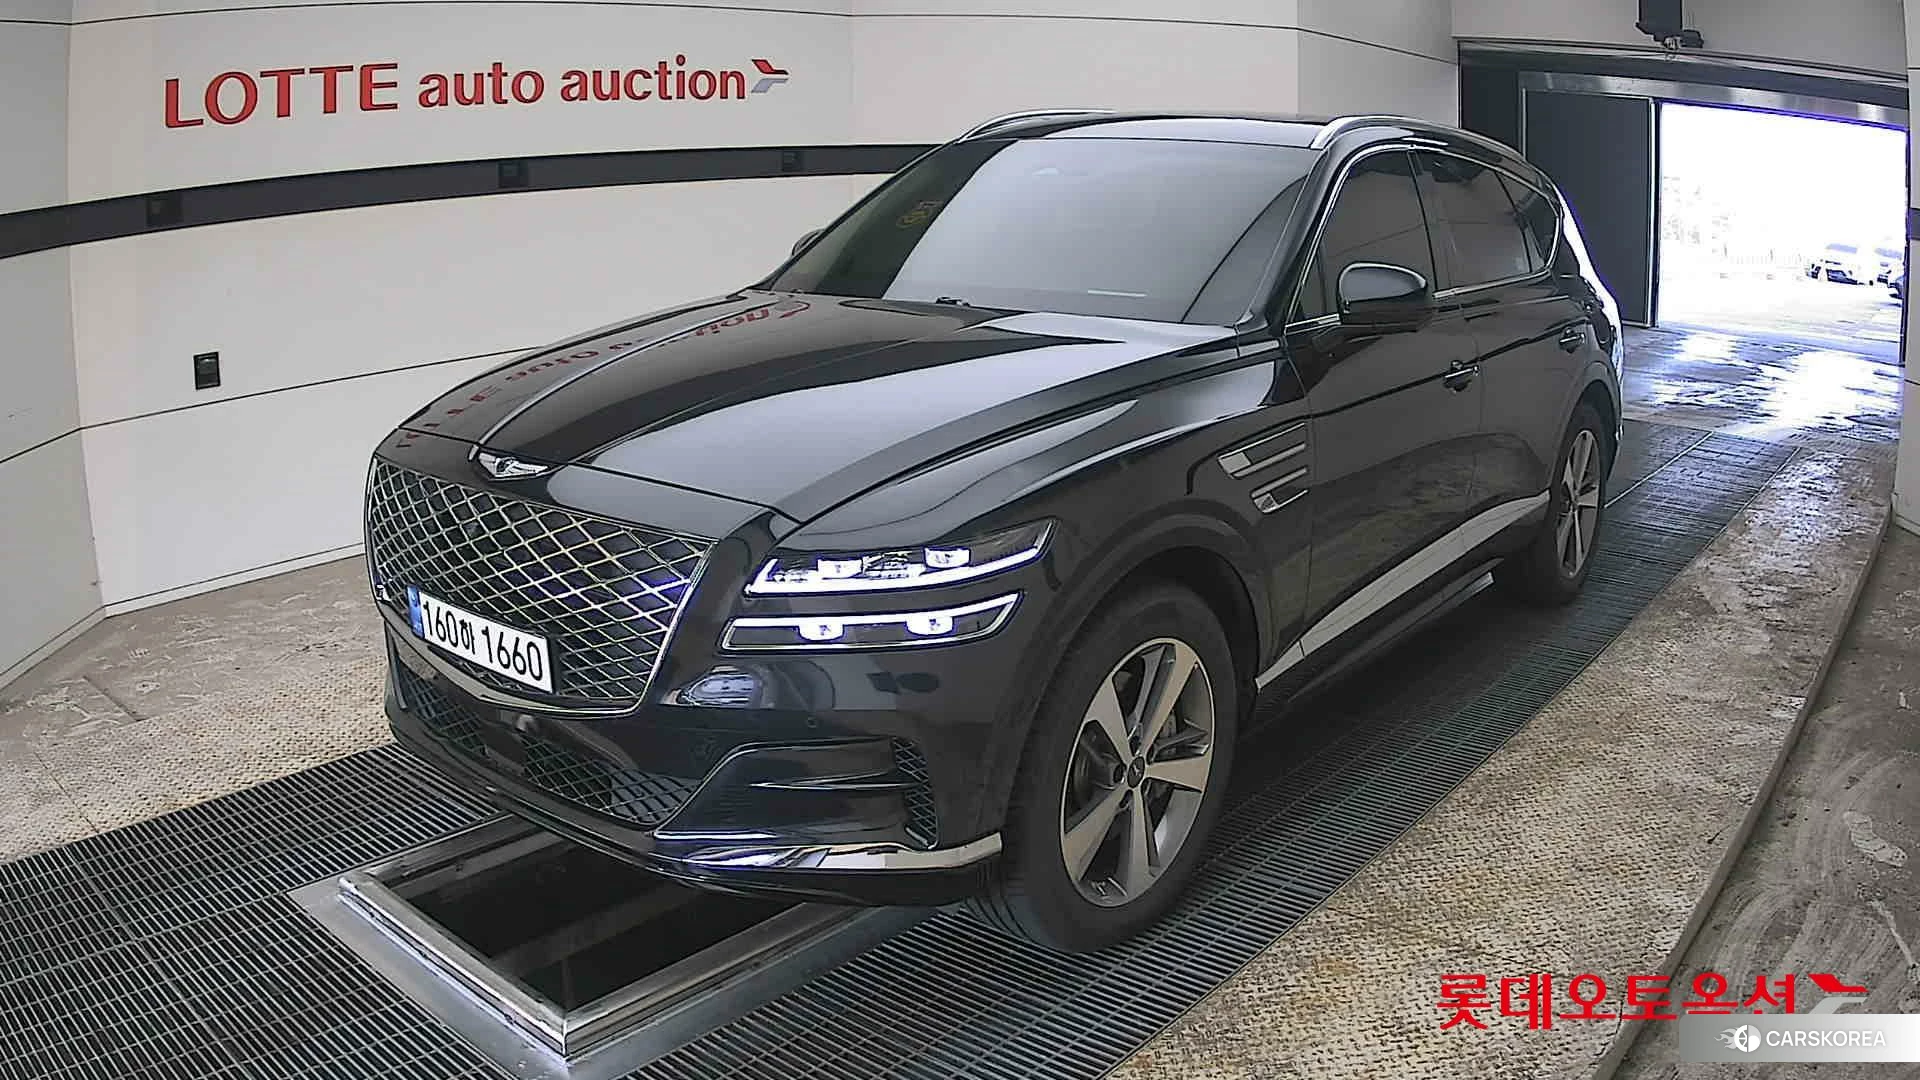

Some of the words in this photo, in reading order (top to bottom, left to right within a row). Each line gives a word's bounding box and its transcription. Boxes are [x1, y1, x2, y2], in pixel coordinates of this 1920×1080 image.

[164, 62, 399, 129] LOTTE
[417, 61, 545, 109] auto
[559, 54, 747, 102] auction
[481, 626, 544, 682] 1660
